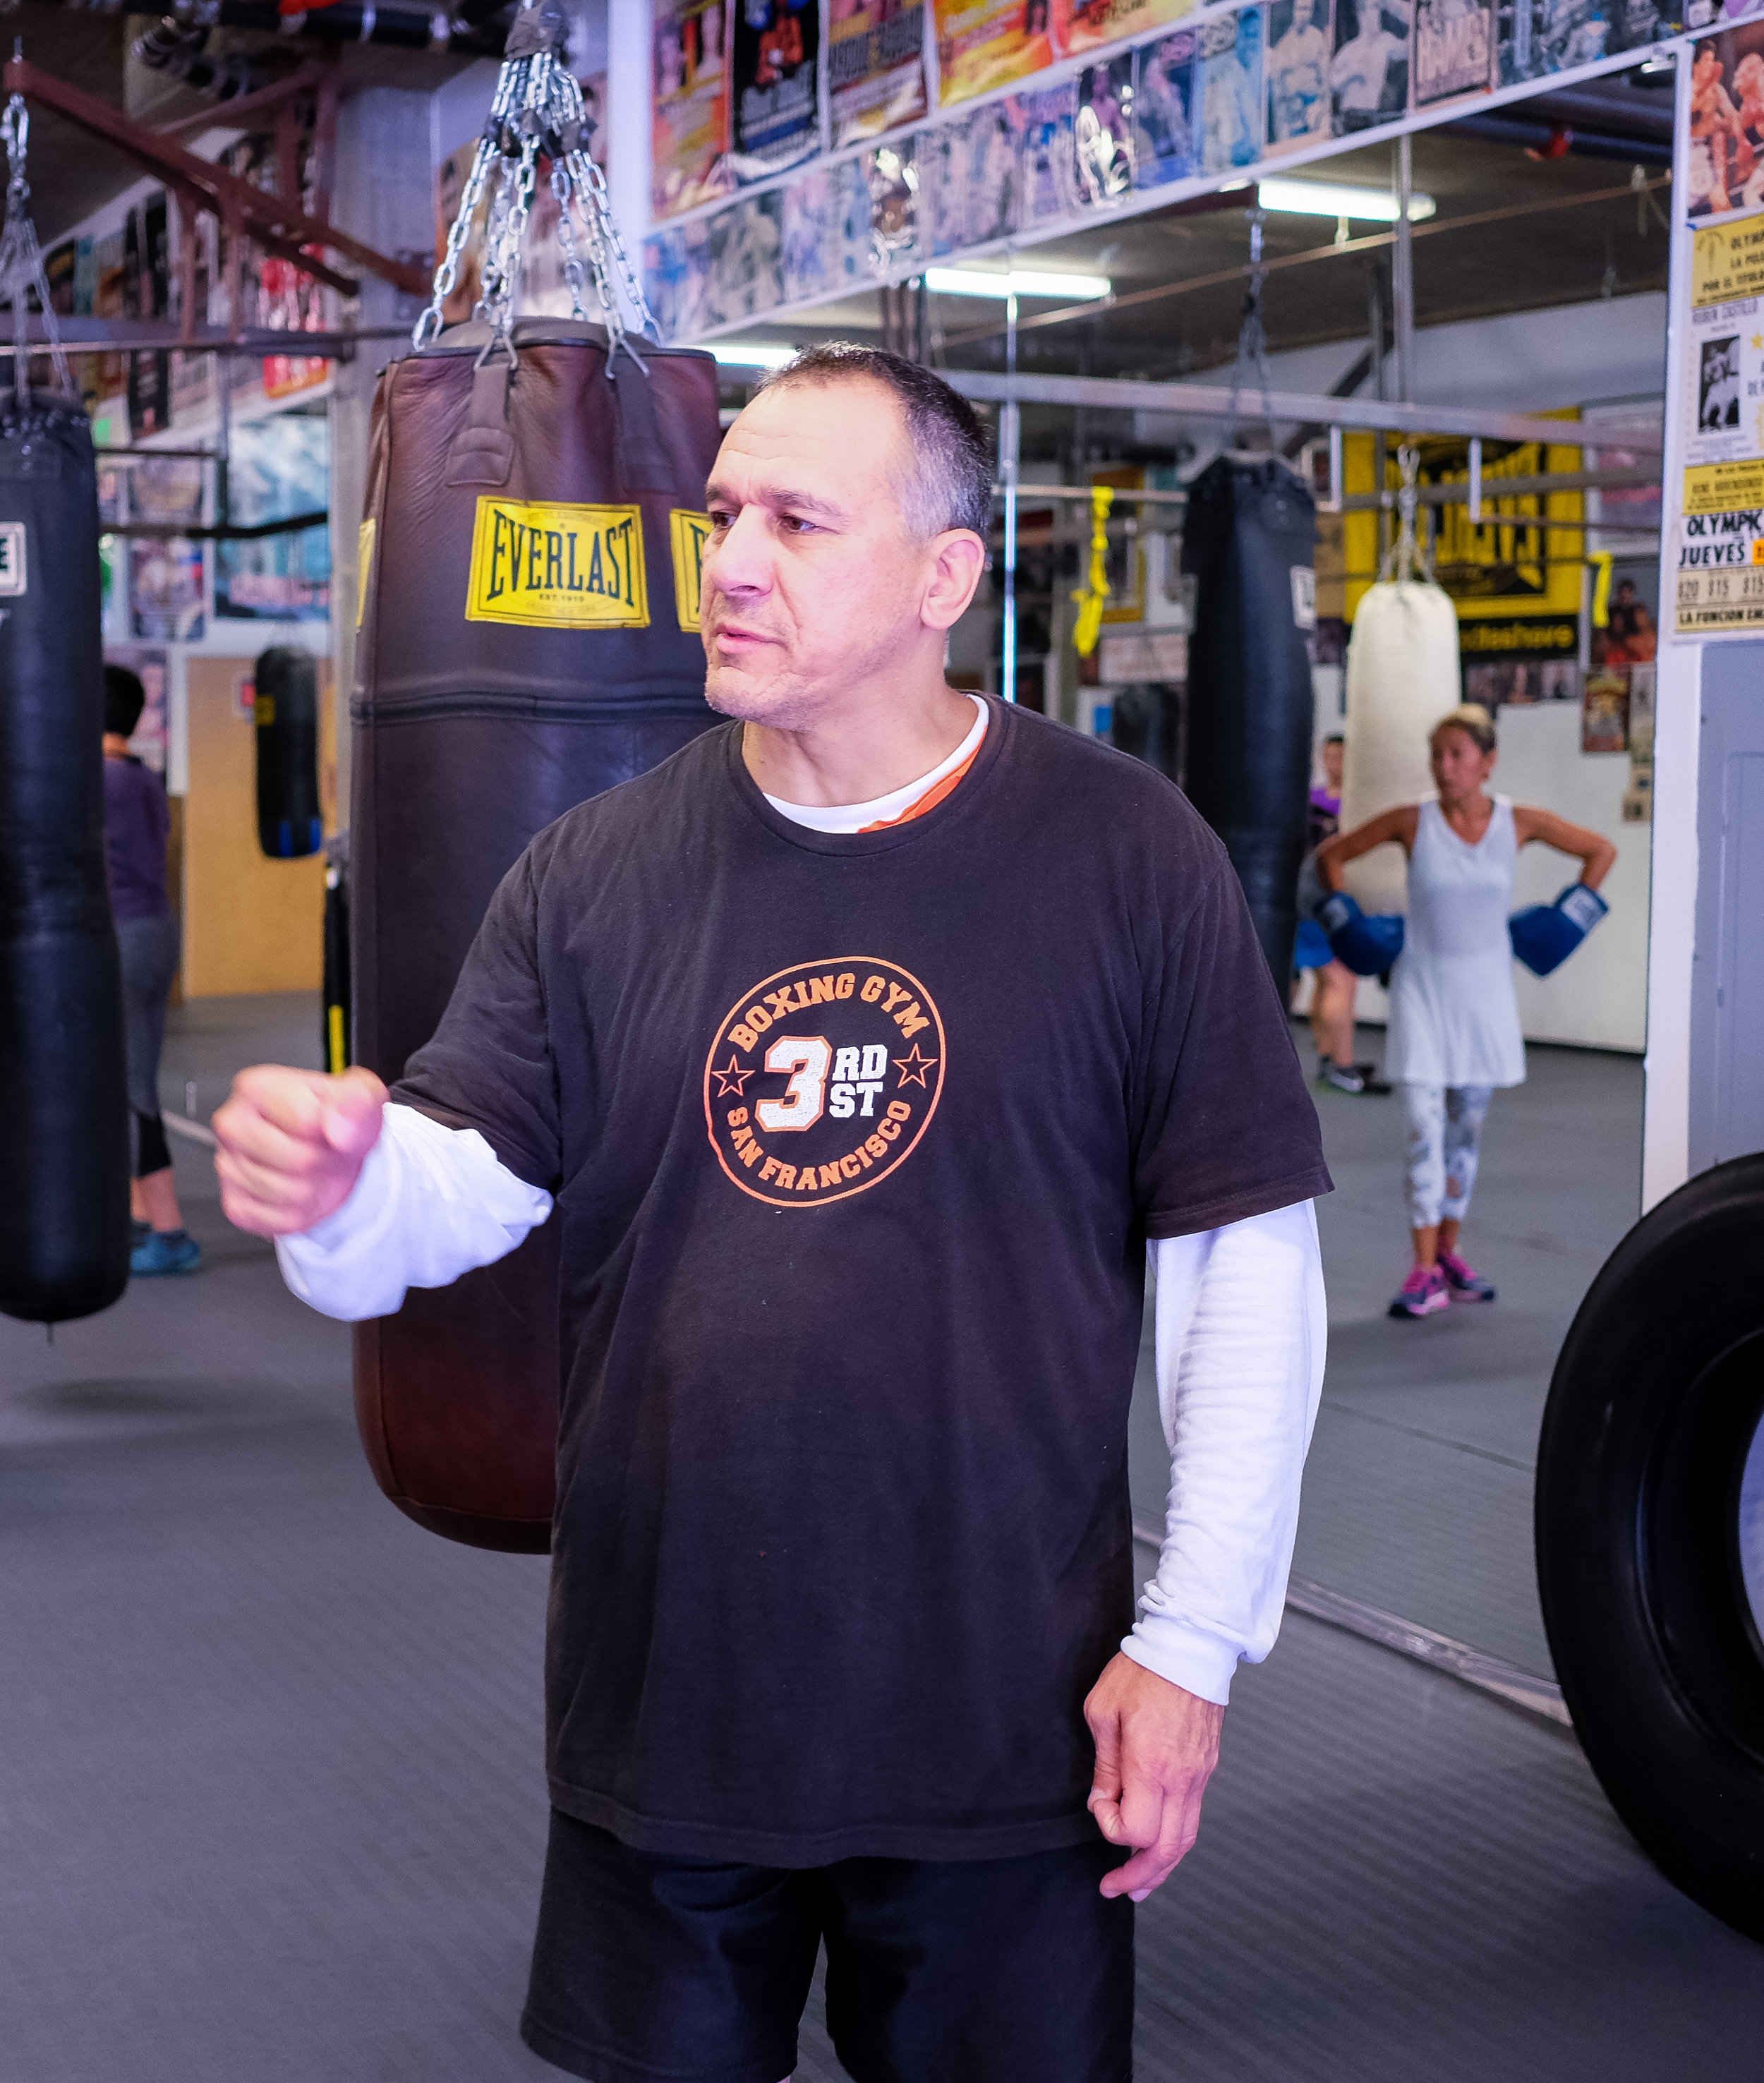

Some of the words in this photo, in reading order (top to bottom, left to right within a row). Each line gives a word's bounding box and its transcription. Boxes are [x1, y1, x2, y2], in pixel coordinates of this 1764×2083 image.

[487, 509, 634, 608] EVERLAST
[1679, 542, 1745, 567] JUEVES
[727, 972, 856, 1053] BOXING
[860, 975, 931, 1039] GYM
[754, 1035, 833, 1133] 3
[832, 1044, 888, 1081] RD
[828, 1082, 883, 1118] ST
[727, 1106, 764, 1168] SAN
[757, 1100, 912, 1190] FRANCISCO
